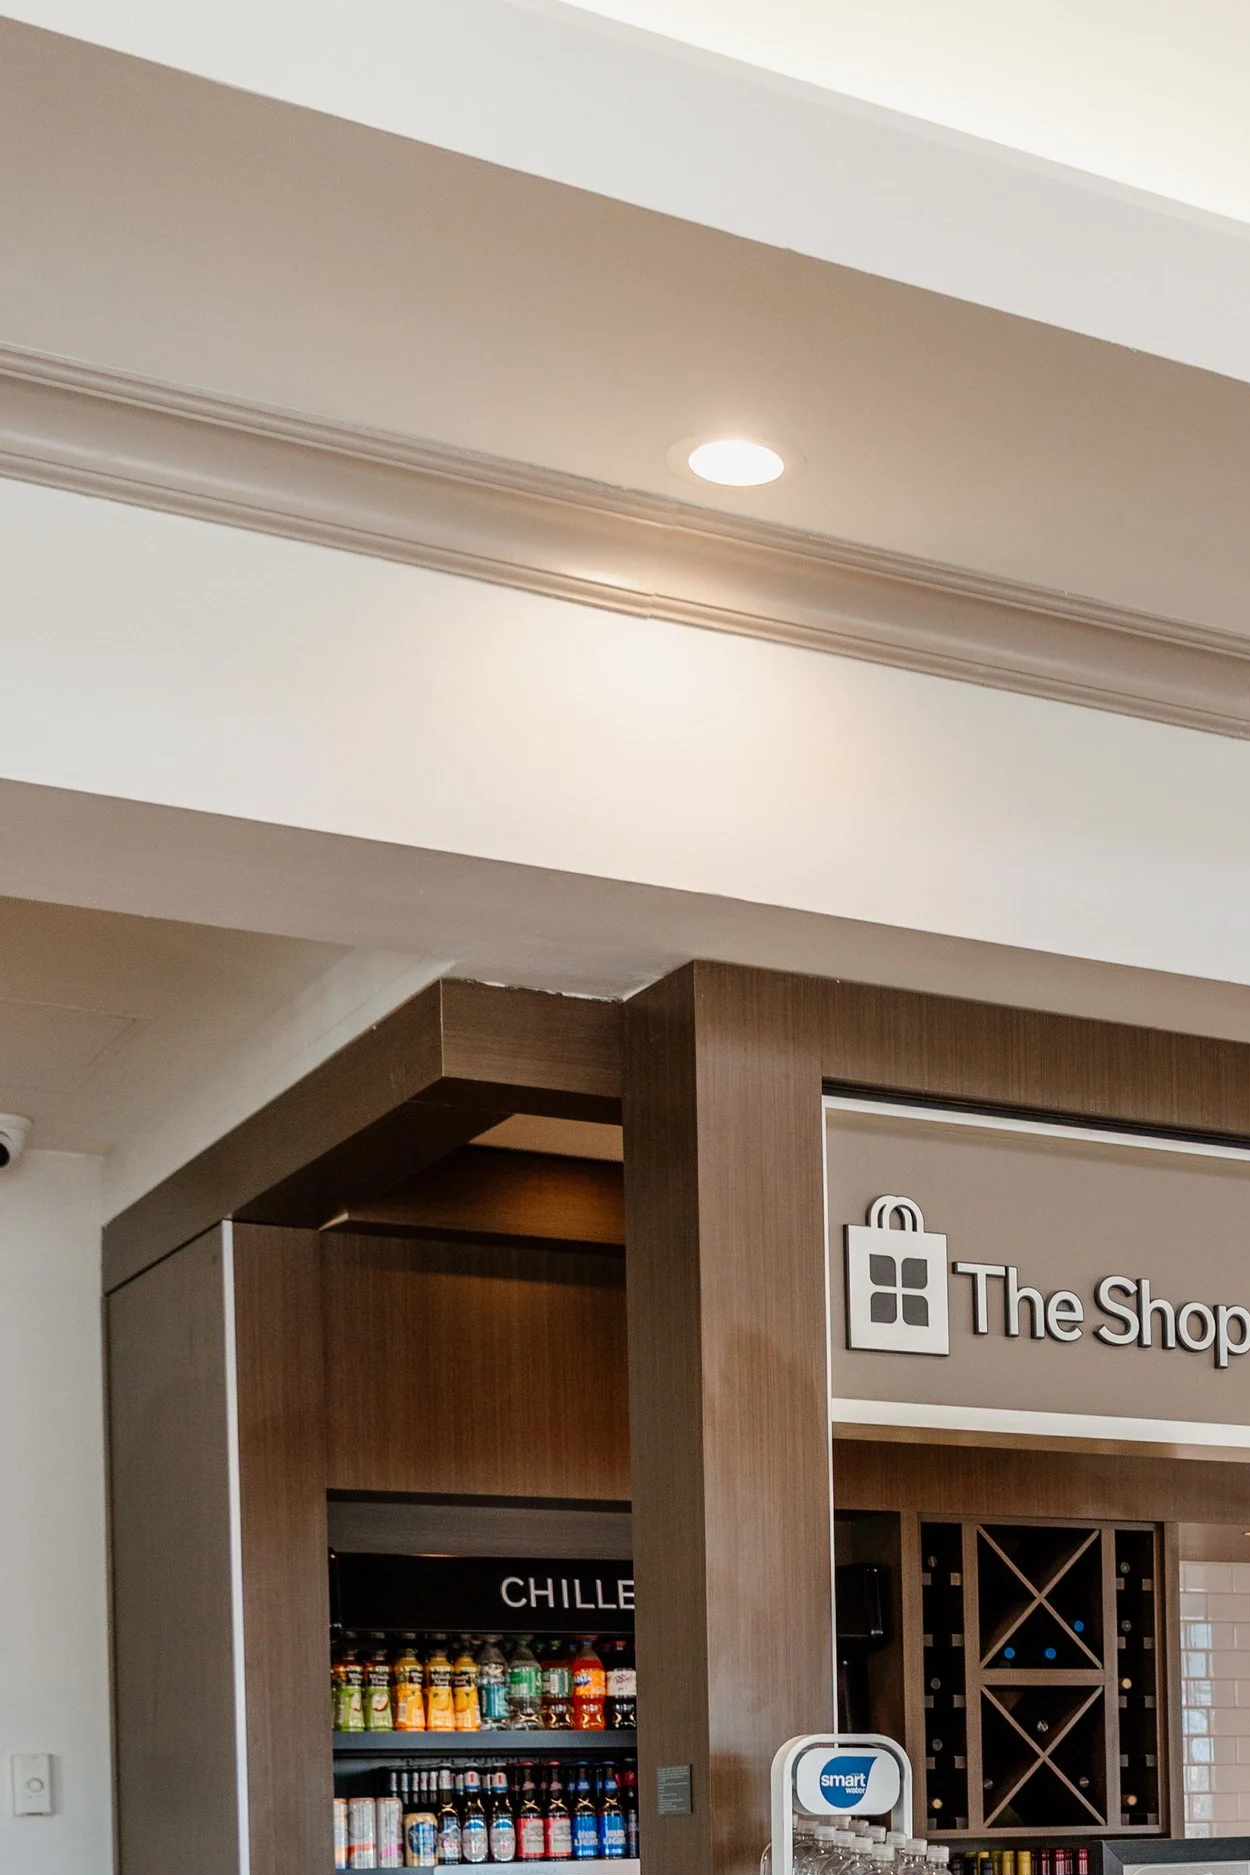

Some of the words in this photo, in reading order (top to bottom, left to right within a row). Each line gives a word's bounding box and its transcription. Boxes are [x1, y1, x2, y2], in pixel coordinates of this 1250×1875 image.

[952, 1261, 1084, 1342] The
[821, 1773, 866, 1788] smart
[845, 1786, 866, 1794] water
